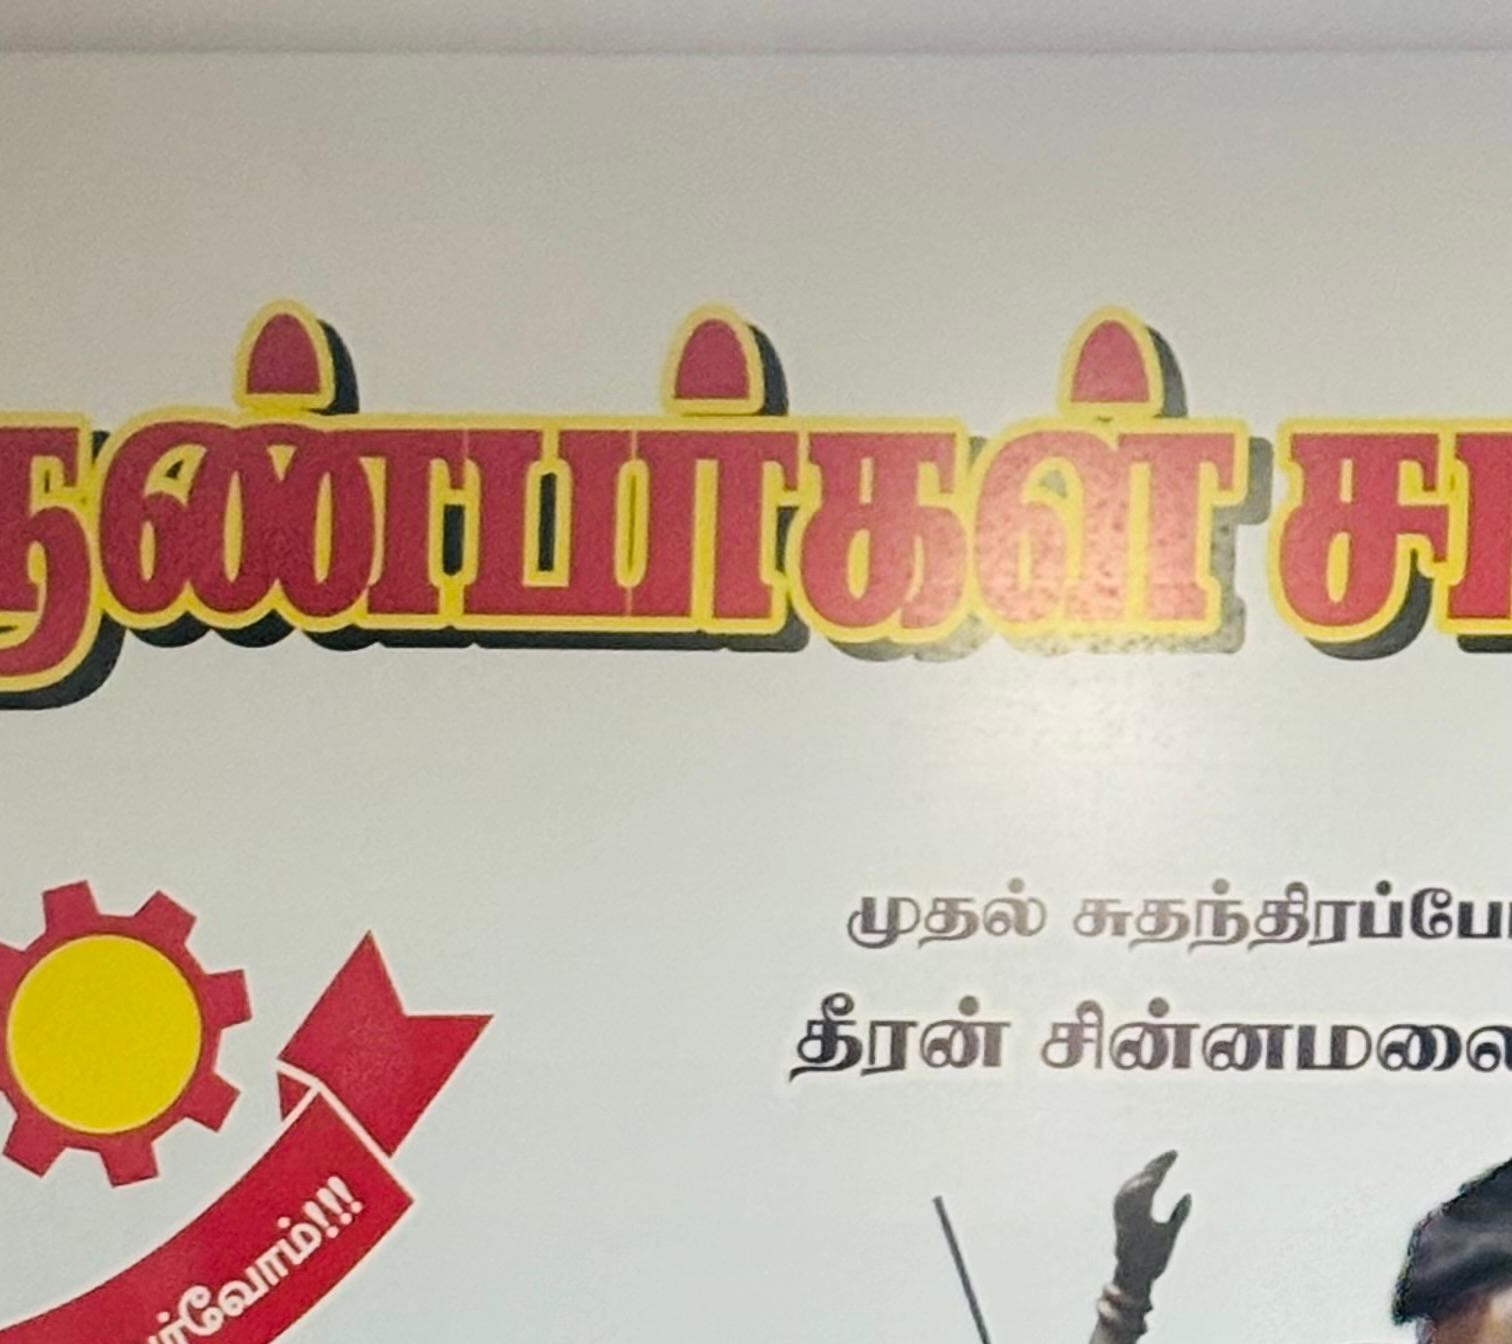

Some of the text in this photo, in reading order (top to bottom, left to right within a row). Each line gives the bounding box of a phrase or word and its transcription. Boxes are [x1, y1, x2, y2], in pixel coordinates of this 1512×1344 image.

[847, 877, 1512, 951] முதல் சுதந்திரப்பே
[789, 992, 1011, 1083] தீரன்
